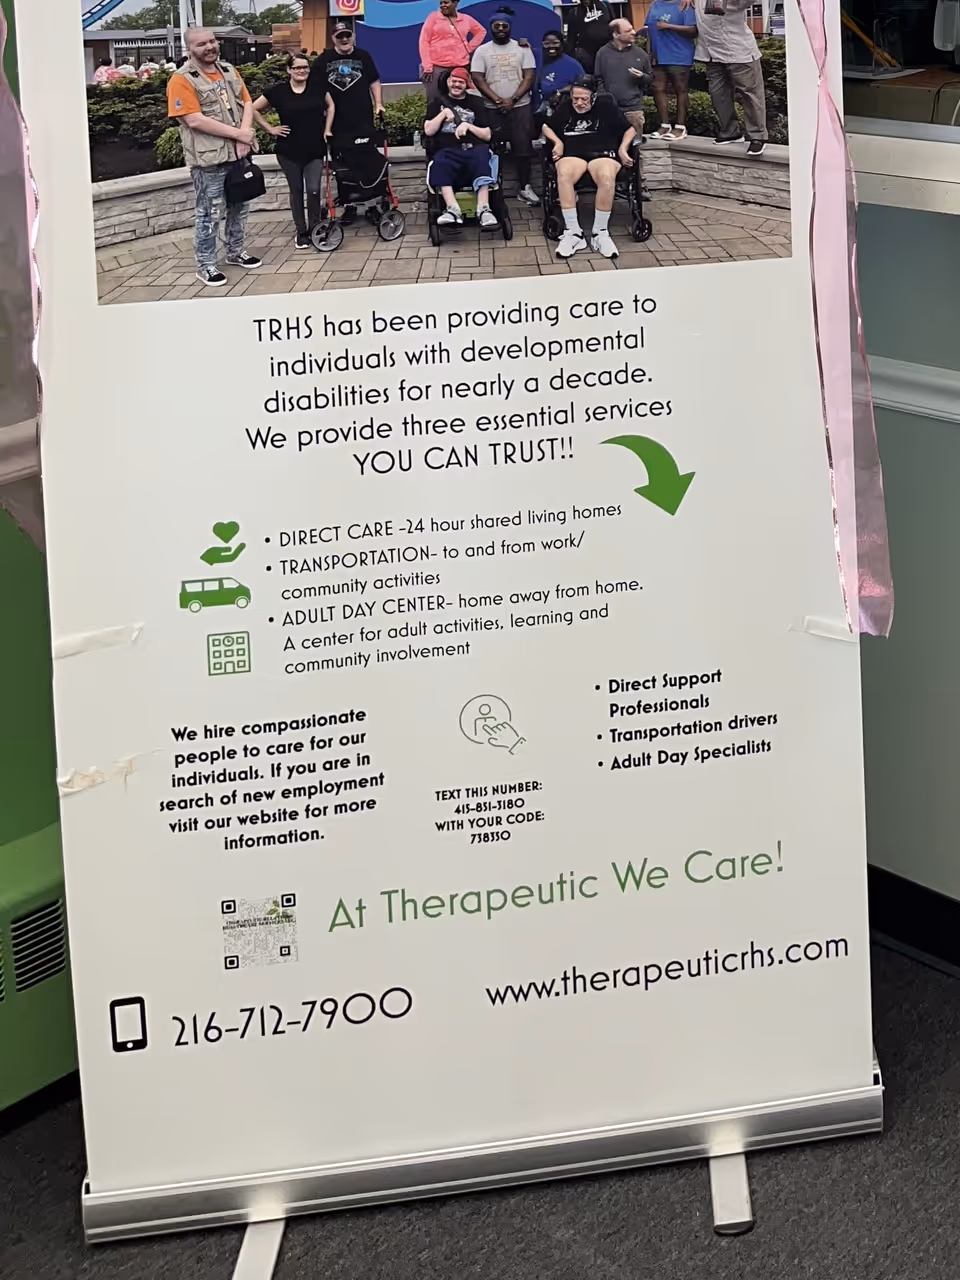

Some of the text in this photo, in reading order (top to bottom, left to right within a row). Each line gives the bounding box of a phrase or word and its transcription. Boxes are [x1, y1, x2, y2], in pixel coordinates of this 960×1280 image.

[253, 294, 656, 342] TRHS has been providing care to
[270, 326, 644, 377] individuals with developmental
[264, 362, 652, 413] disabilities for nearly a decade.
[245, 398, 672, 452] We provide three essential services
[353, 436, 573, 475] YOU CAN TRUST!!
[280, 505, 621, 547] DIRECT CARE -24 hour shared living homes
[279, 530, 584, 575] TRANSPORTATION- to and from work/
[281, 572, 440, 600] community activities
[282, 580, 642, 626] ADULT DAY CENTER- home away from home.
[283, 603, 608, 651] A center for adult activities, learning and
[285, 641, 470, 674] community involvement
[609, 669, 721, 693] Direct Support
[610, 694, 709, 717] Professionals
[171, 709, 366, 741] We hire compassionate
[610, 714, 777, 743] Transportation drivers
[175, 733, 366, 768] people to care for our
[611, 739, 771, 770] Adult Day Specialists
[172, 753, 370, 787] individuals. If you are in
[160, 773, 384, 811] search of new employment
[435, 781, 542, 801] TEXT THIS NUMBER:
[454, 798, 525, 815] 415-851-3180
[169, 799, 376, 832] visit our website for more
[435, 811, 545, 831] WITH YOUR CODE:
[225, 829, 324, 850] information.
[471, 830, 511, 844] 738350
[329, 898, 366, 932] At
[380, 871, 598, 923] Therapeutic
[611, 858, 668, 893] We
[685, 840, 783, 883] Care!
[485, 938, 848, 1006] www.therapeuticrhs.com
[172, 987, 412, 1046] 216-712-7900
